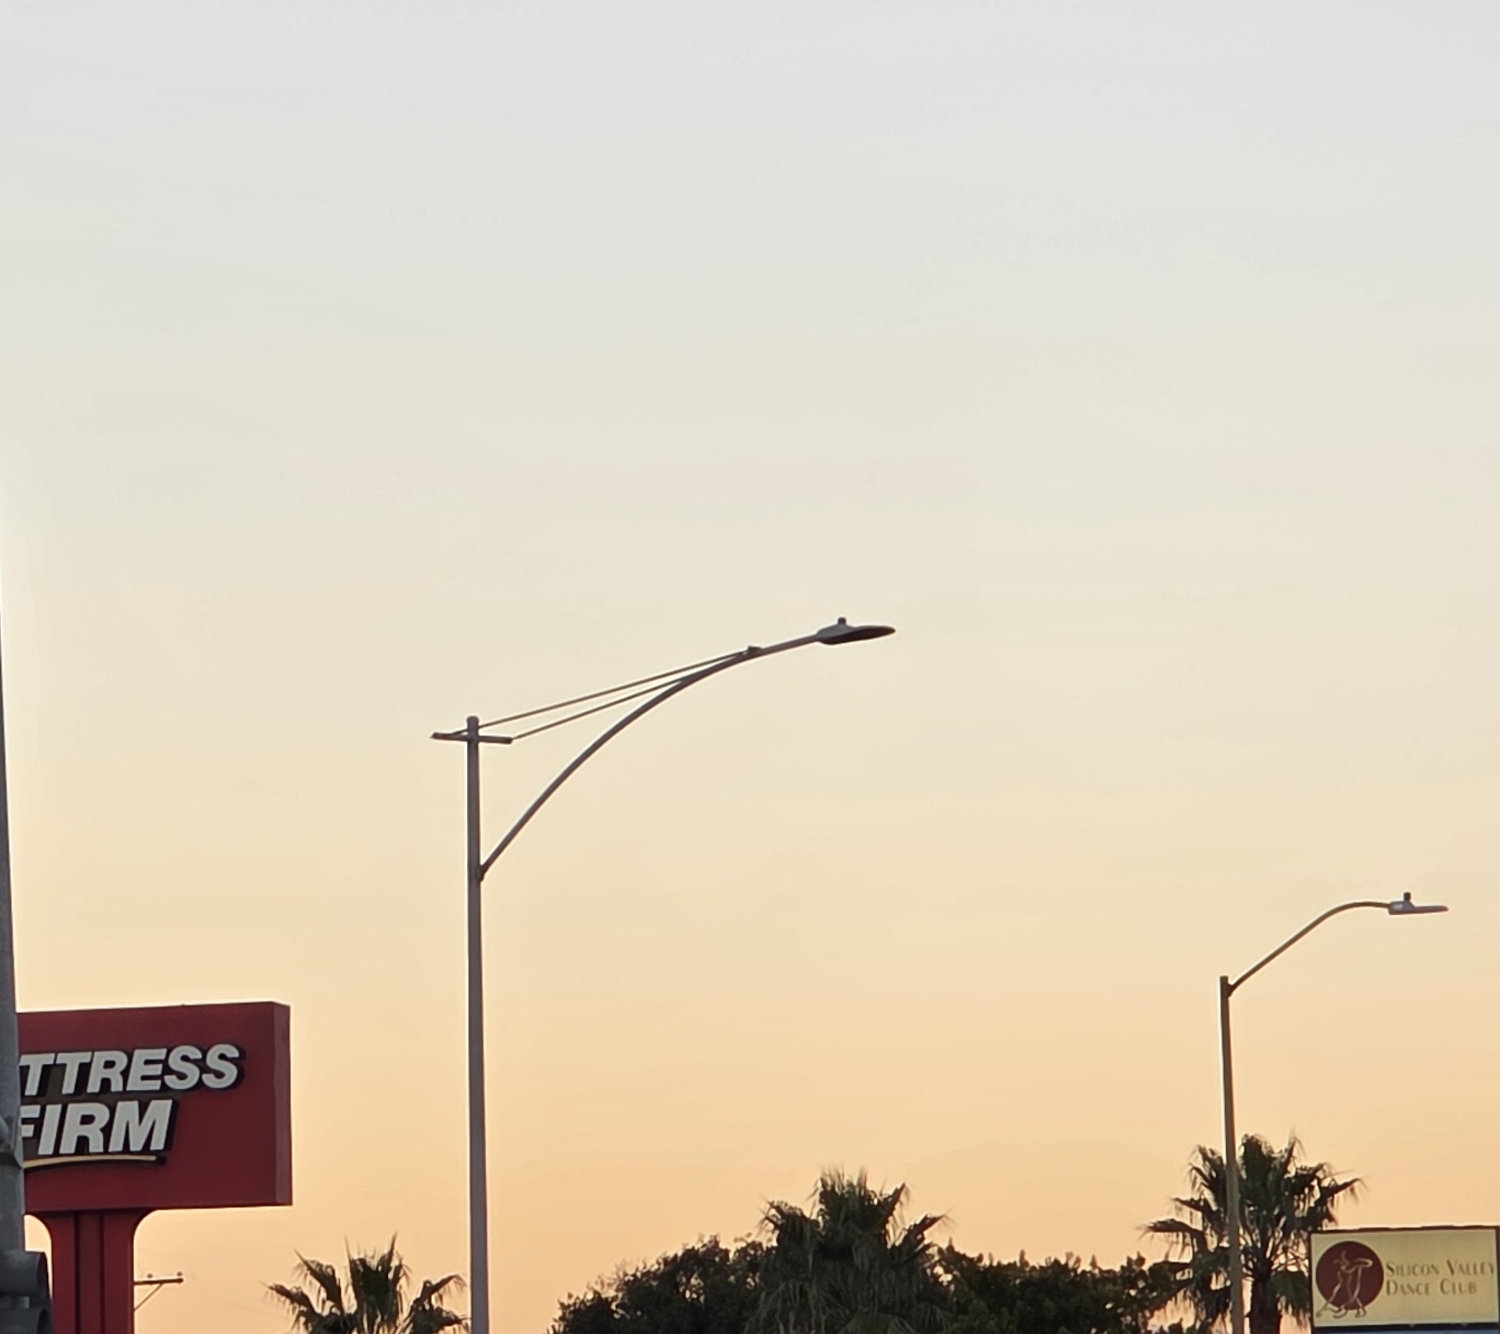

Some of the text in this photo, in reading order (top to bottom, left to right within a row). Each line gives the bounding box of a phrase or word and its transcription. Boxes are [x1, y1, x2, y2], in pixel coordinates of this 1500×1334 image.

[1446, 1259, 1495, 1276] VALLEY
[1386, 1278, 1477, 1296] DANCE CLUB
